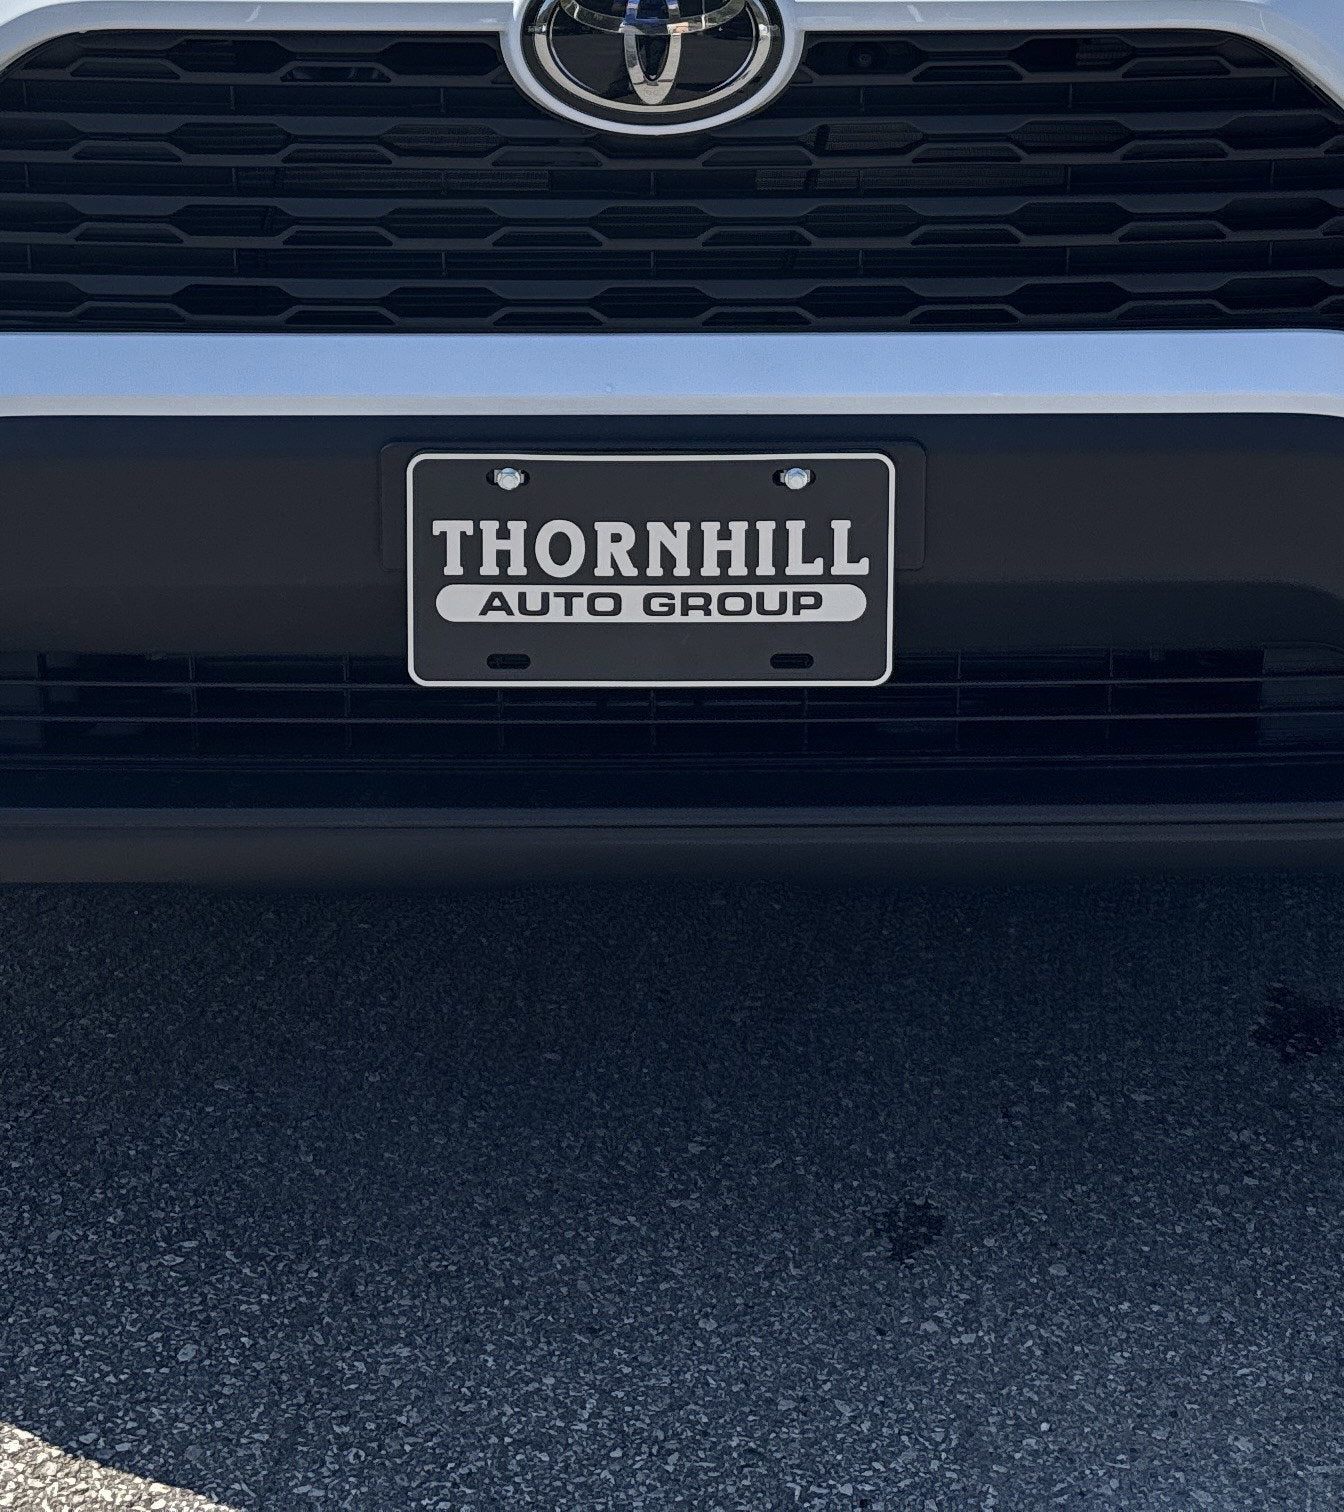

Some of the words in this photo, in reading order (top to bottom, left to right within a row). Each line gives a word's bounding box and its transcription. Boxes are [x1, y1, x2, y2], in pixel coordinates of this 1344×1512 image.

[432, 519, 870, 578] THORNHILL
[478, 591, 623, 617] AUTO
[642, 590, 823, 617] GROUP
